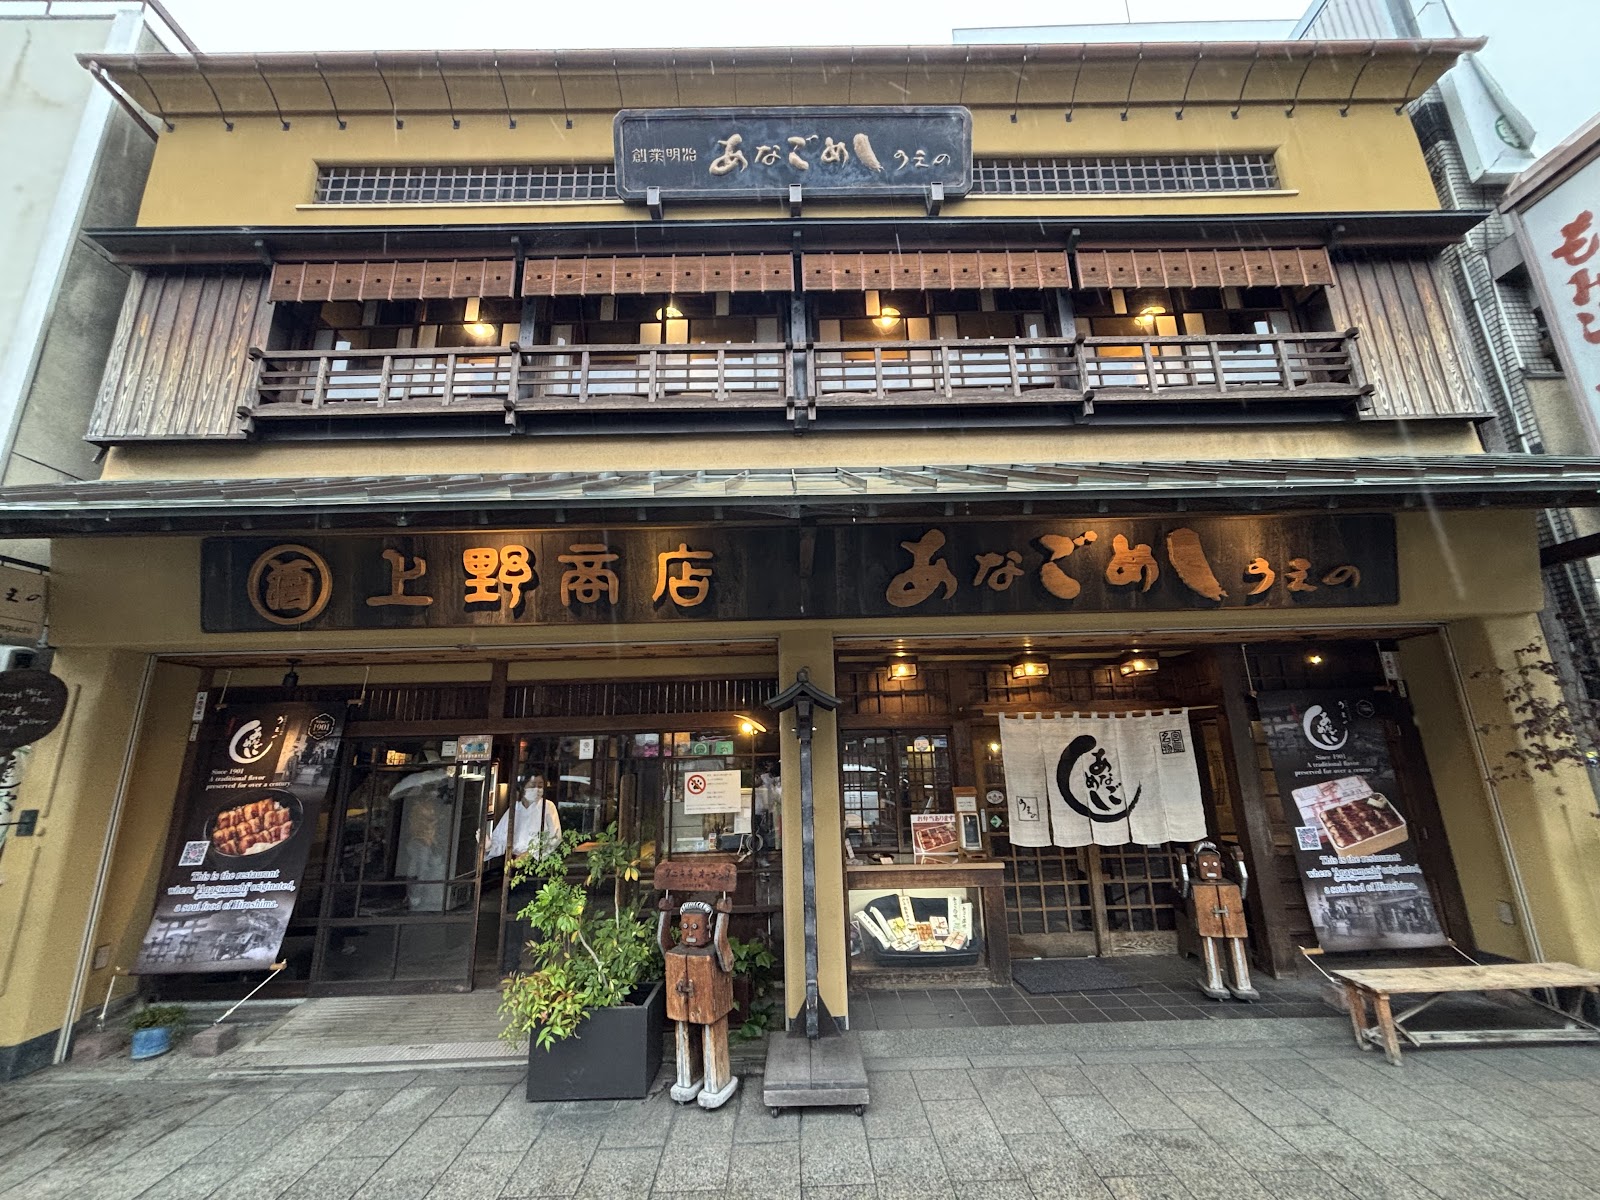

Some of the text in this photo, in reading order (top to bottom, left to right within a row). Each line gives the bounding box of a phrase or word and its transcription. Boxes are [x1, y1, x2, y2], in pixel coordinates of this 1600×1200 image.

[632, 132, 951, 177] 創業明治 あなごめし うえの
[886, 527, 1361, 608] あなごめし うえの
[365, 542, 715, 609] 上野商店
[312, 723, 331, 731] 1901
[229, 767, 245, 775] 1901
[1319, 852, 1402, 865] This is the restaurant
[191, 868, 280, 882] This is the restaurant
[1305, 867, 1332, 878] where
[167, 884, 196, 896] where
[1330, 884, 1348, 894] soul
[1347, 882, 1366, 893] food
[181, 901, 201, 912] soul
[200, 900, 222, 911] food
